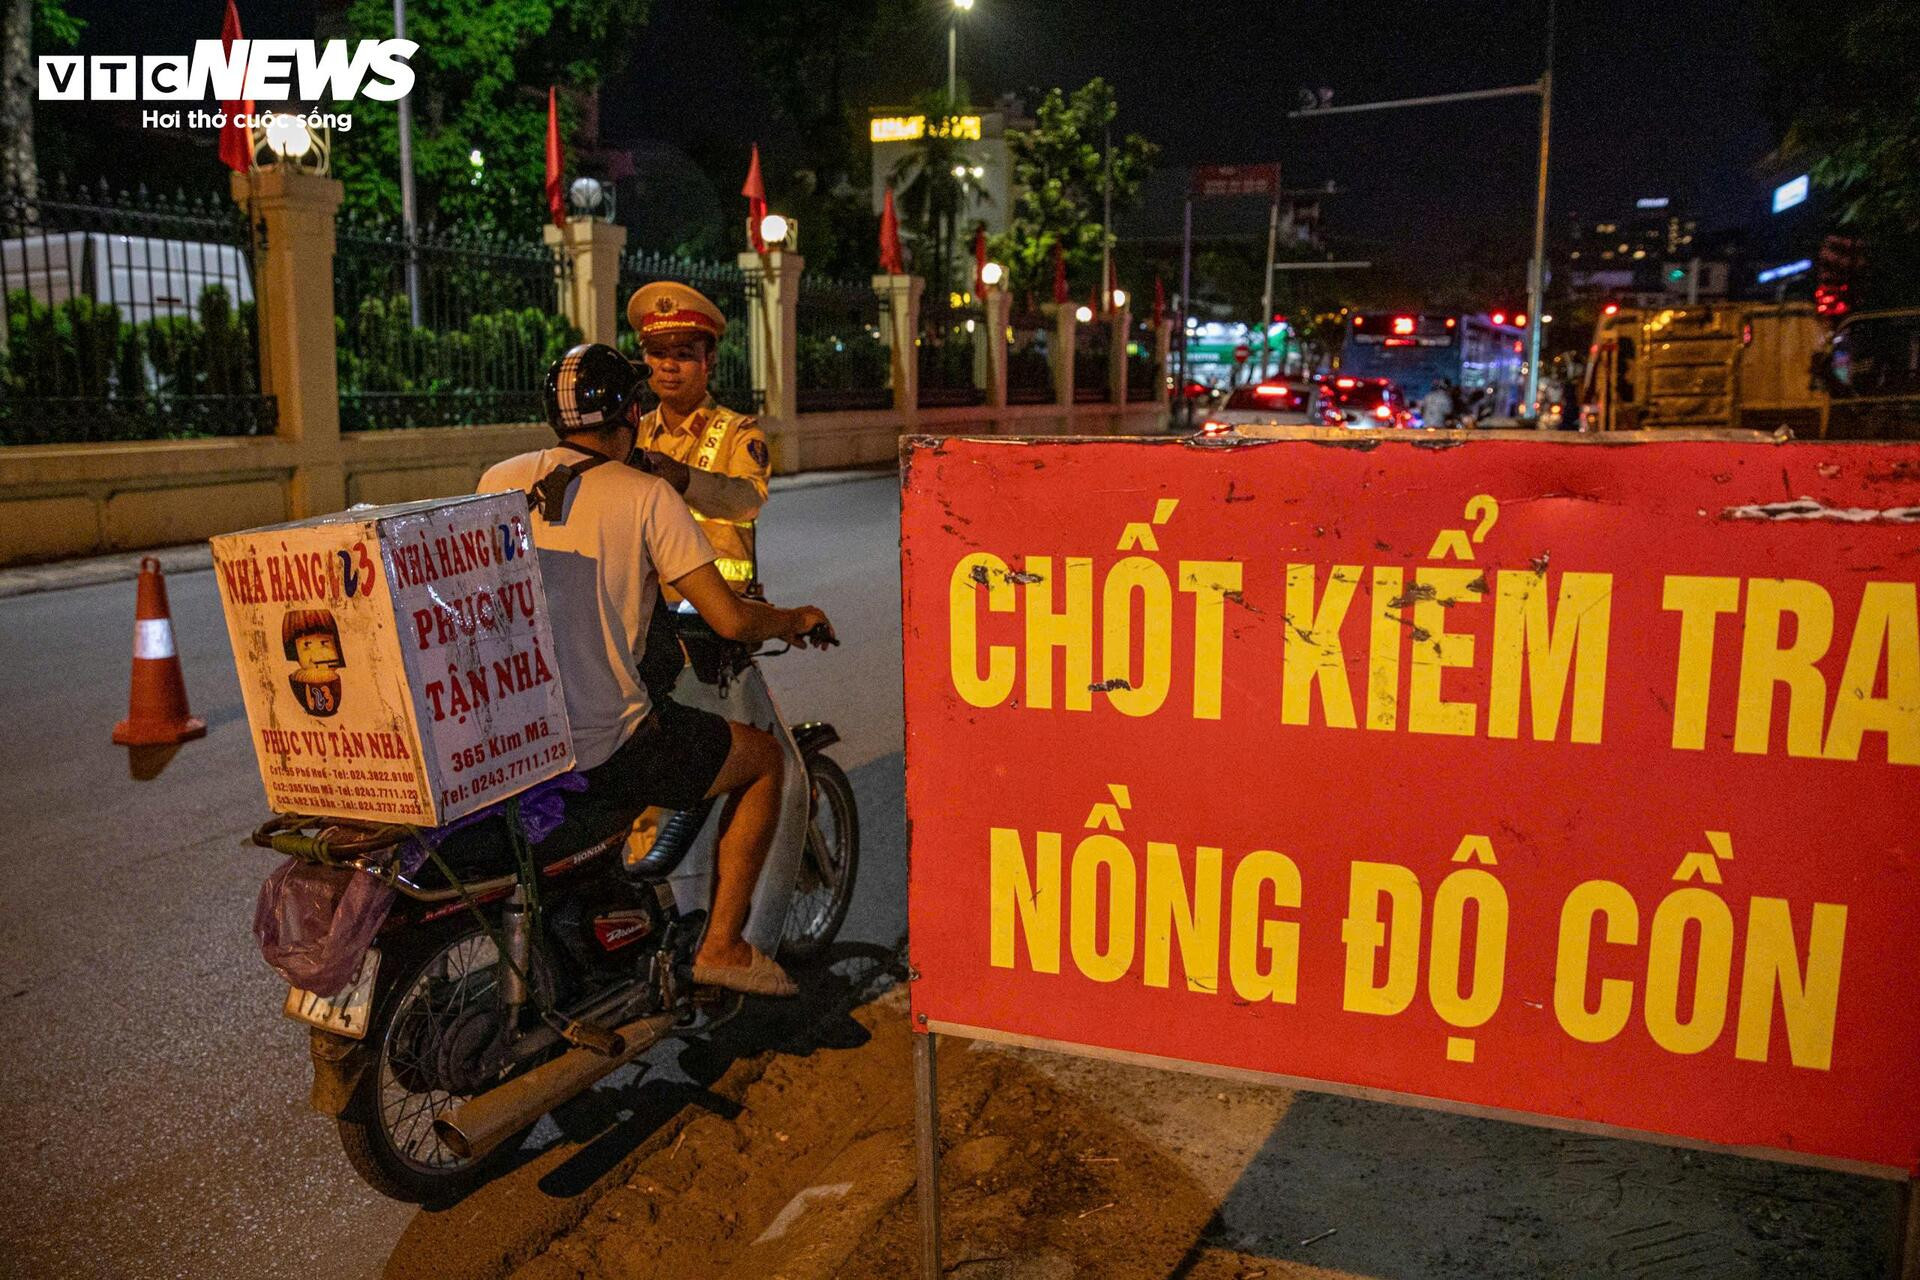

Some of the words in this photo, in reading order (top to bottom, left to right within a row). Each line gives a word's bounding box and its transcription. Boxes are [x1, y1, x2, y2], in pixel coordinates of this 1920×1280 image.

[222, 544, 268, 605] NHÀ
[267, 541, 326, 602] HÀNG
[391, 530, 439, 589] NHÀ
[435, 523, 490, 578] HÀNG
[413, 592, 497, 650] PHỤC
[497, 577, 535, 627] VỤ
[949, 498, 1243, 720] CHỐT
[1281, 493, 1613, 745] KIỂM
[1661, 575, 1920, 766] TRA
[425, 663, 490, 724] TẬN
[493, 636, 553, 699] NHÀ
[262, 728, 301, 761] PHỤC
[302, 731, 327, 763] VỤ
[328, 724, 366, 764] TẬN
[366, 724, 410, 760] NHÀ
[333, 769, 349, 780] Tel:
[442, 784, 469, 807] Tel:
[471, 741, 567, 795] 0243.7711.123
[451, 743, 486, 773] 365
[488, 731, 522, 758] Kim
[524, 717, 550, 743] Mã
[573, 843, 607, 864] HONDA
[989, 783, 1303, 1005] NỒNG
[1342, 834, 1510, 1062] ĐỘ
[1552, 829, 1848, 1072] CỒN
